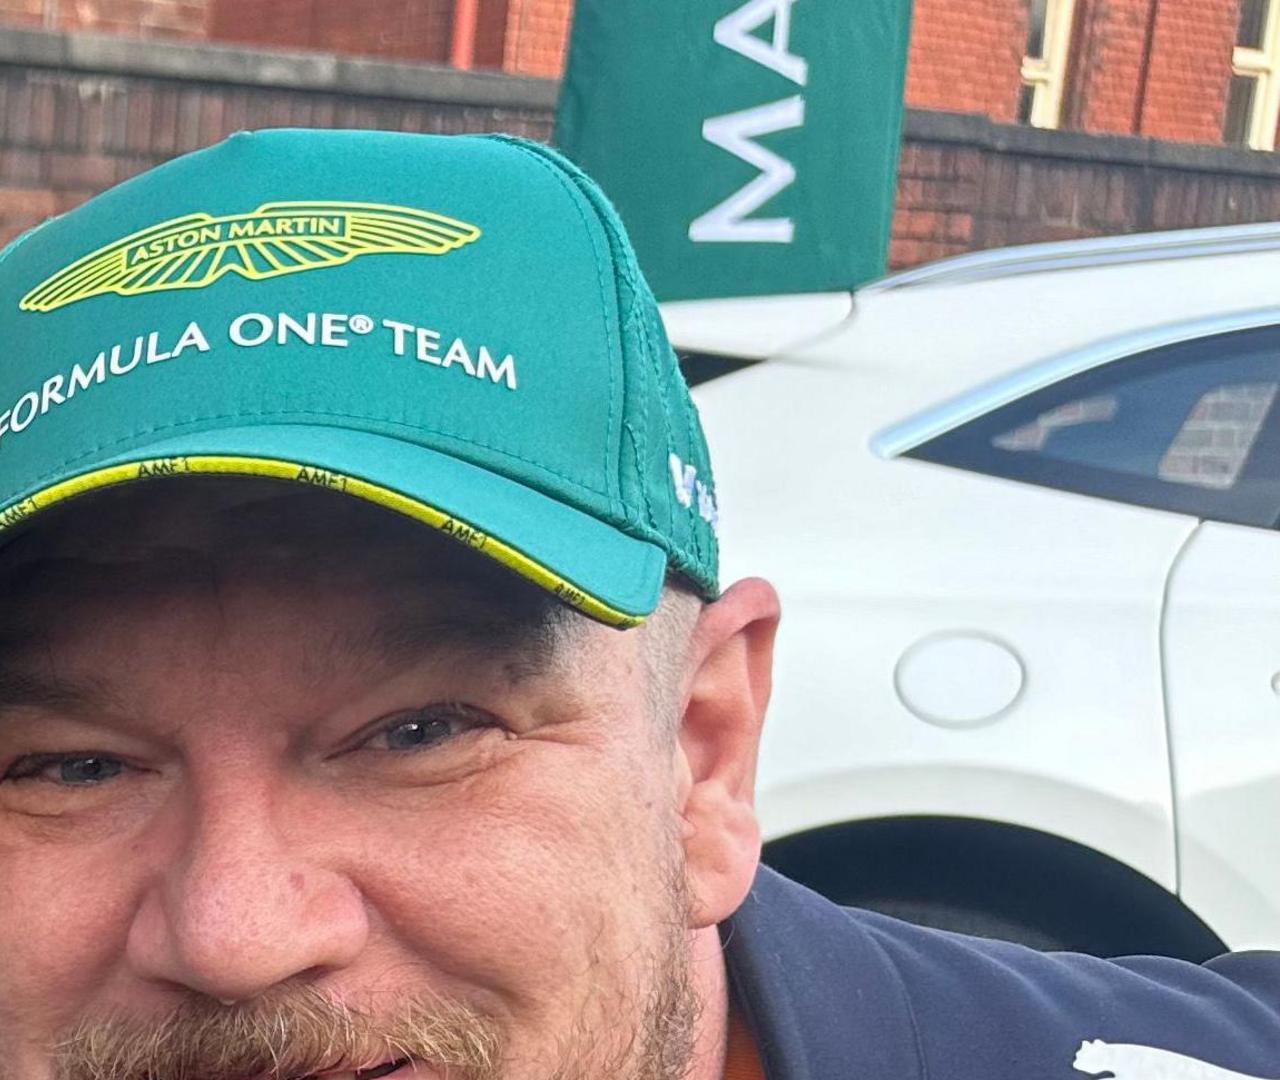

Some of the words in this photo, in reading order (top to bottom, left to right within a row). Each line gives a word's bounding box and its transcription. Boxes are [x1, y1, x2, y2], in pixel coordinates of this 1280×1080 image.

[688, 0, 808, 243] MA
[133, 222, 224, 266] ASTON
[227, 214, 340, 242] MARTIN
[382, 318, 519, 391] TEAM
[139, 455, 189, 479] AMF1
[296, 465, 348, 492] AMF1
[441, 517, 489, 550] AMF1
